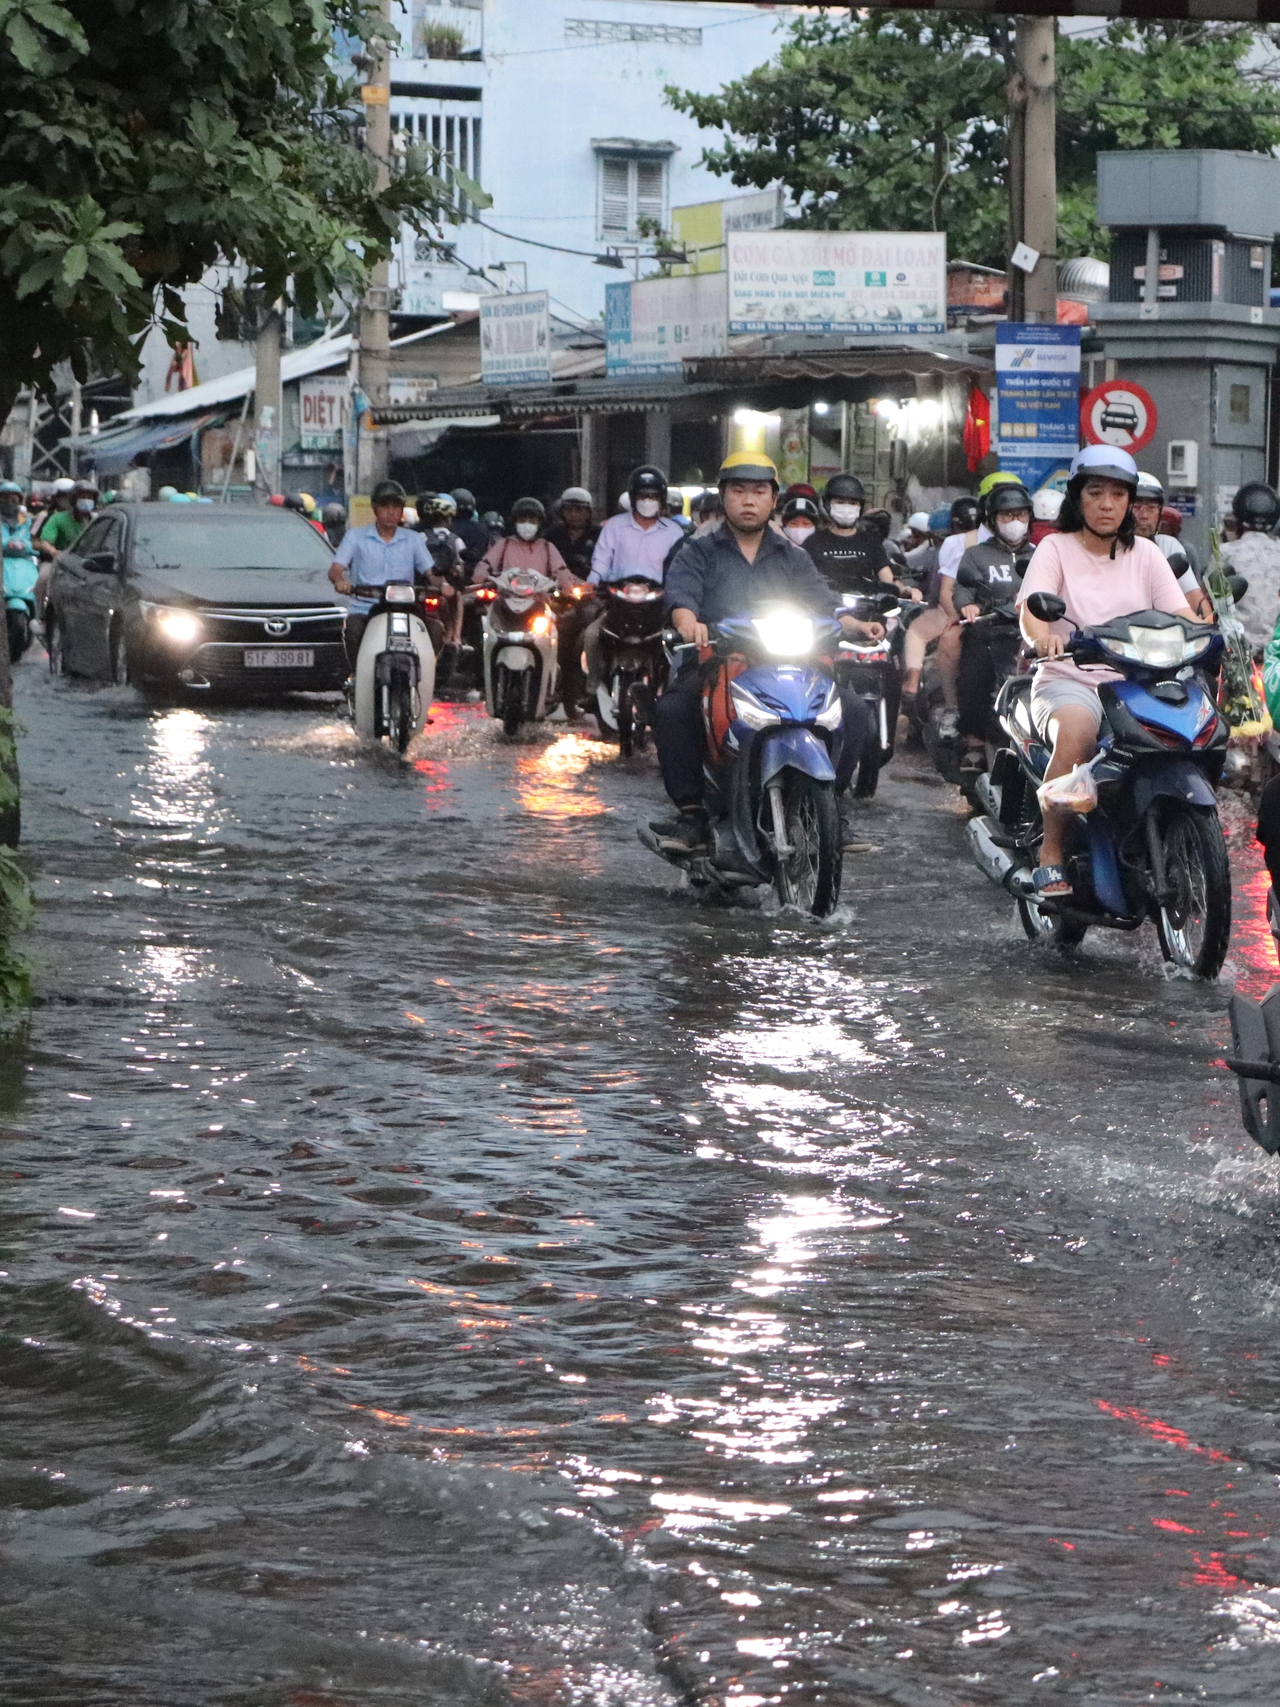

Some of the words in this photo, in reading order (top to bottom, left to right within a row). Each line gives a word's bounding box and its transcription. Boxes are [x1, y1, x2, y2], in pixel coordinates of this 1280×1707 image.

[895, 247, 939, 267] LOAN
[303, 389, 335, 430] DIỆT
[246, 652, 268, 665] 51F
